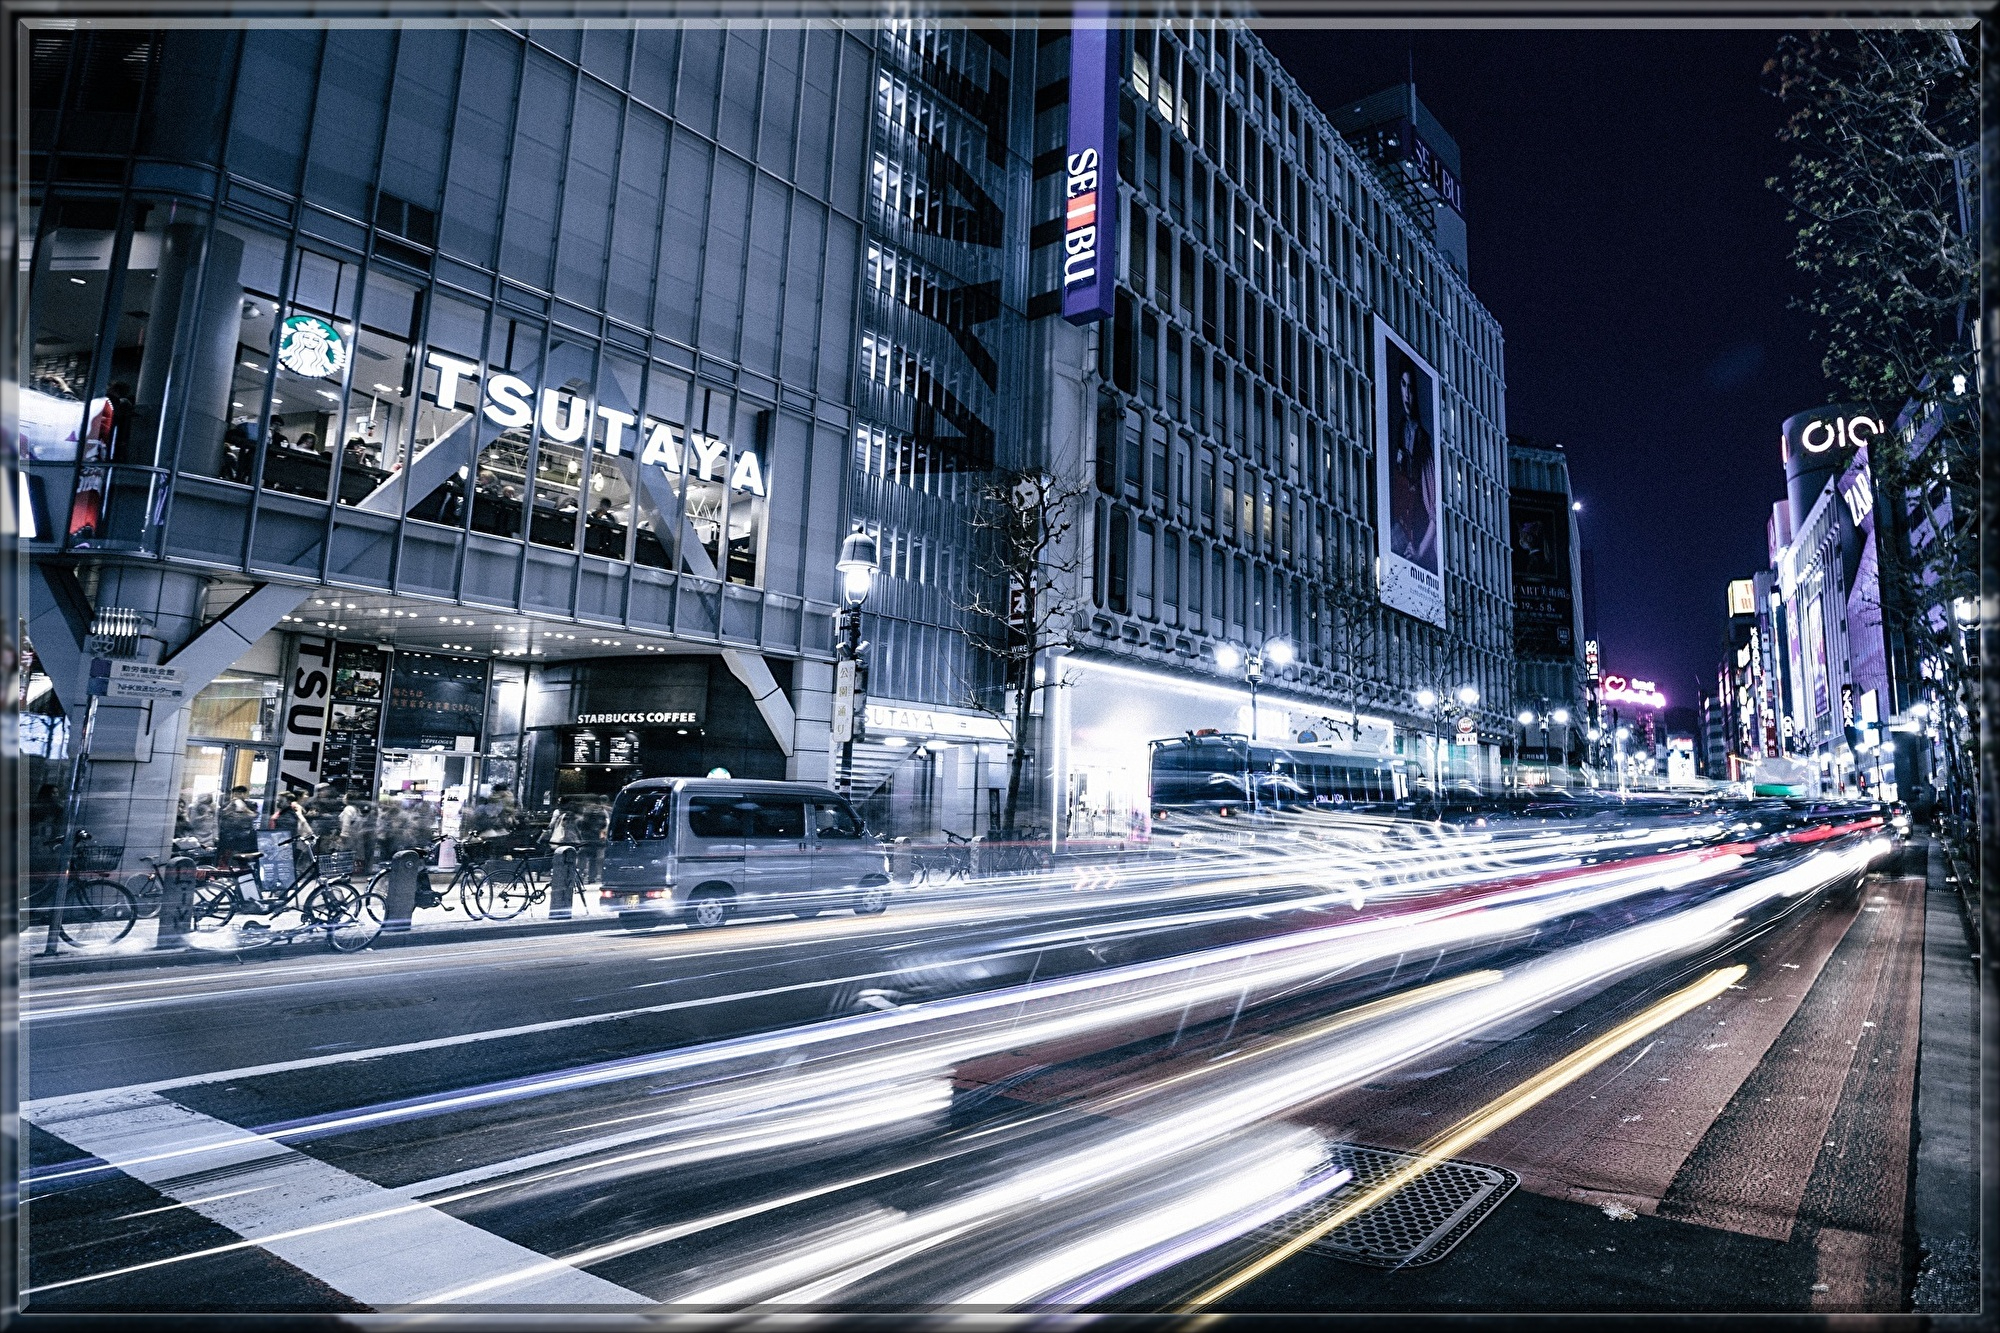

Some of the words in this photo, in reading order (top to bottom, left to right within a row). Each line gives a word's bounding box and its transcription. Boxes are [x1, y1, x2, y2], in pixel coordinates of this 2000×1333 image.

[1415, 139, 1461, 213] SEIBU
[1063, 147, 1098, 286] SEIBU
[428, 352, 766, 497] TSUTAYA
[1844, 465, 1874, 527] ZAR
[577, 712, 645, 724] STARBUCKS
[646, 712, 697, 723] COFFEE
[837, 667, 850, 735] 公園通り
